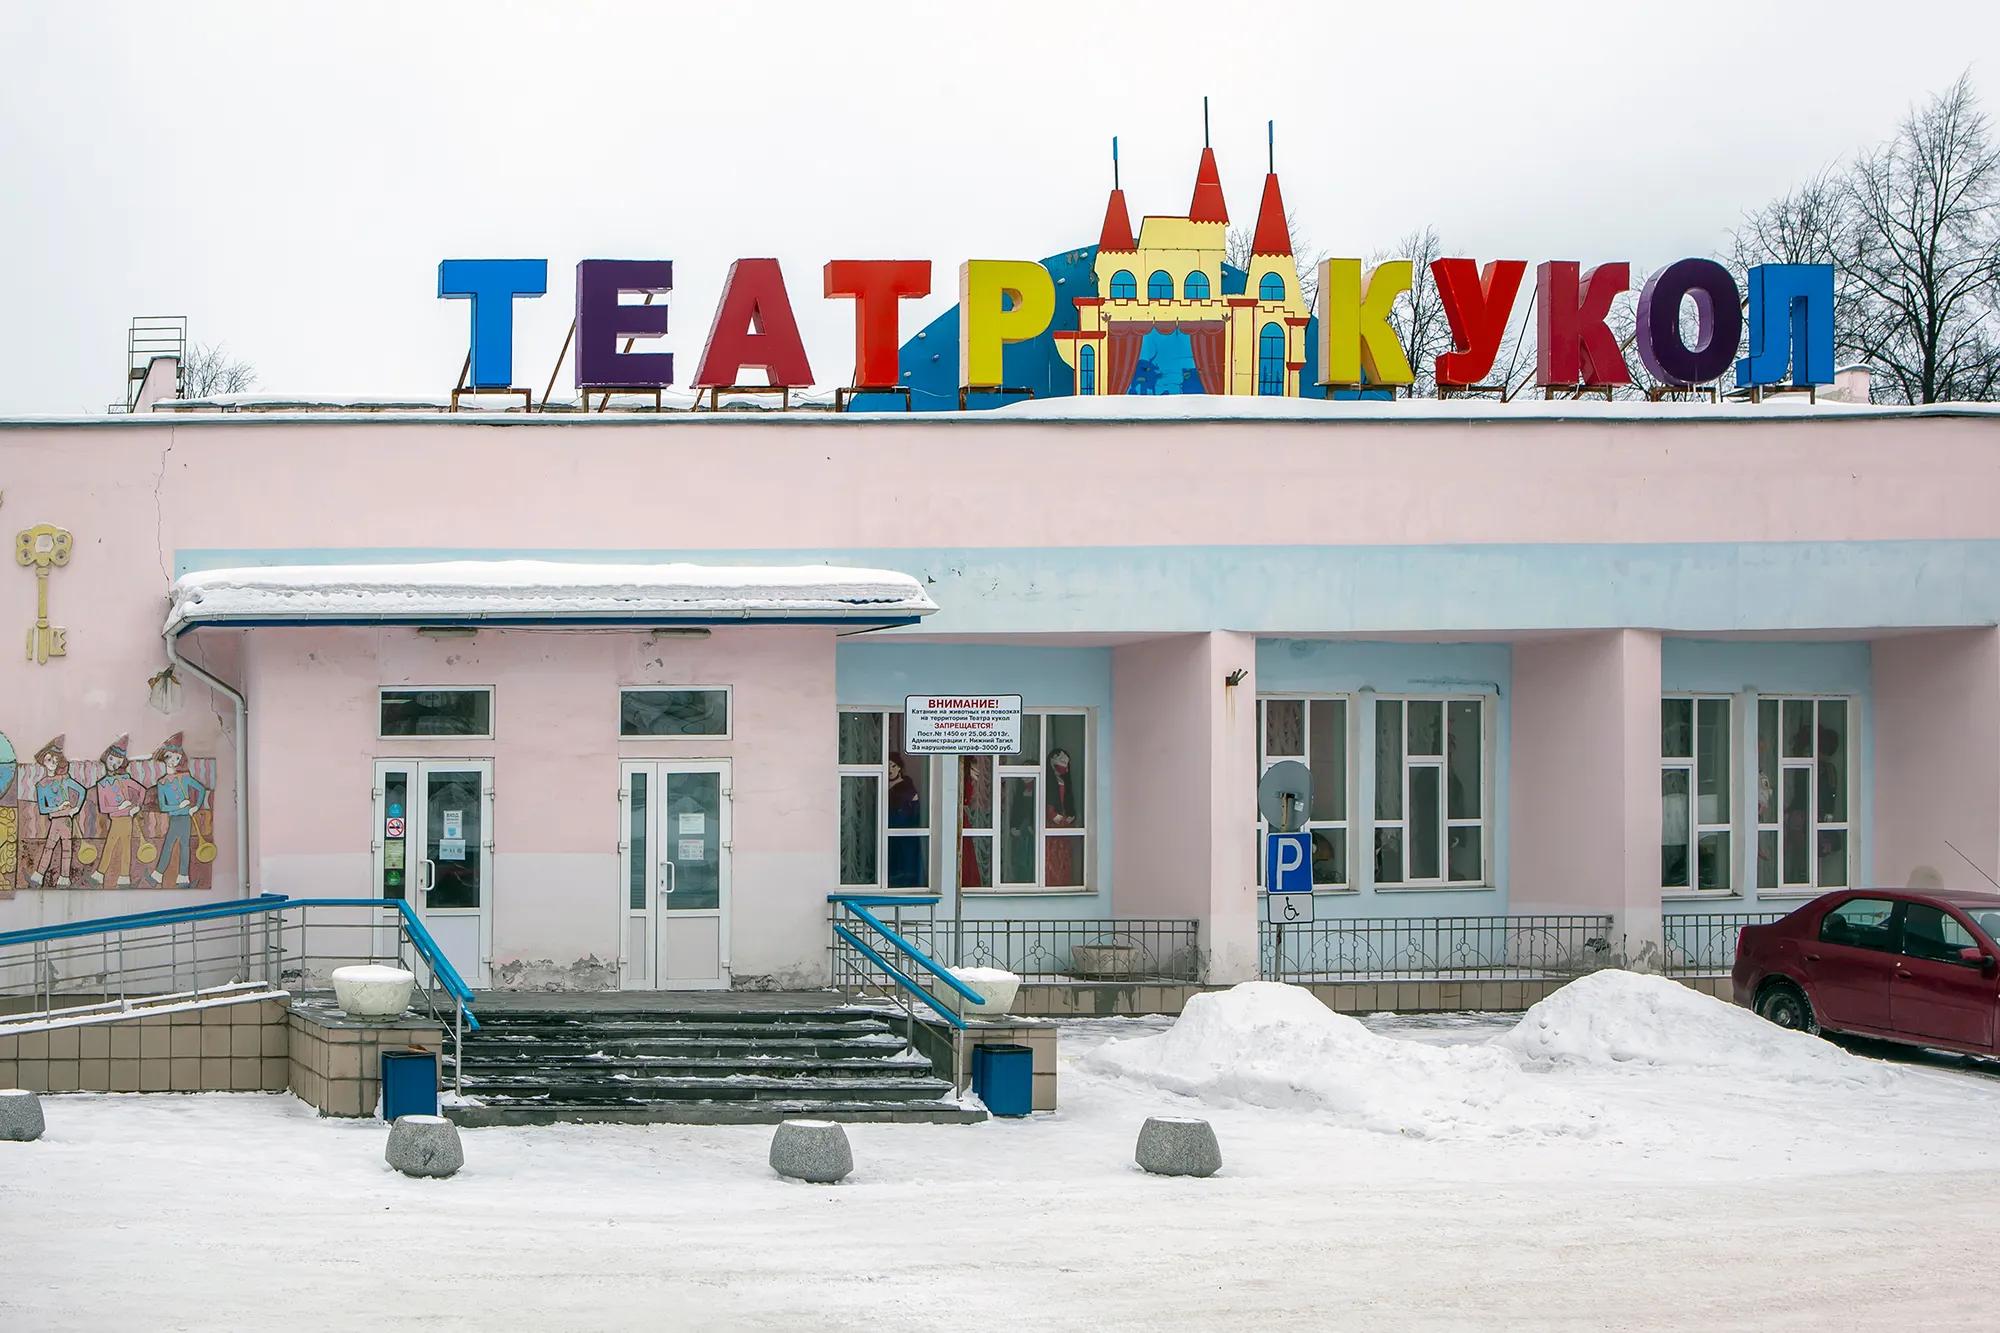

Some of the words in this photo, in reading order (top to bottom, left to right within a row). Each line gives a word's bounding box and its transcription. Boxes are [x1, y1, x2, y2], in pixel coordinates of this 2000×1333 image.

[438, 258, 1055, 389] ТЕАТР
[1318, 257, 1835, 387] КУКОЛ
[928, 699, 999, 709] ВНИМАНИЕ!
[934, 722, 993, 730] ЗАПРЕЩАЕТСЯ!
[1276, 838, 1303, 890] P
